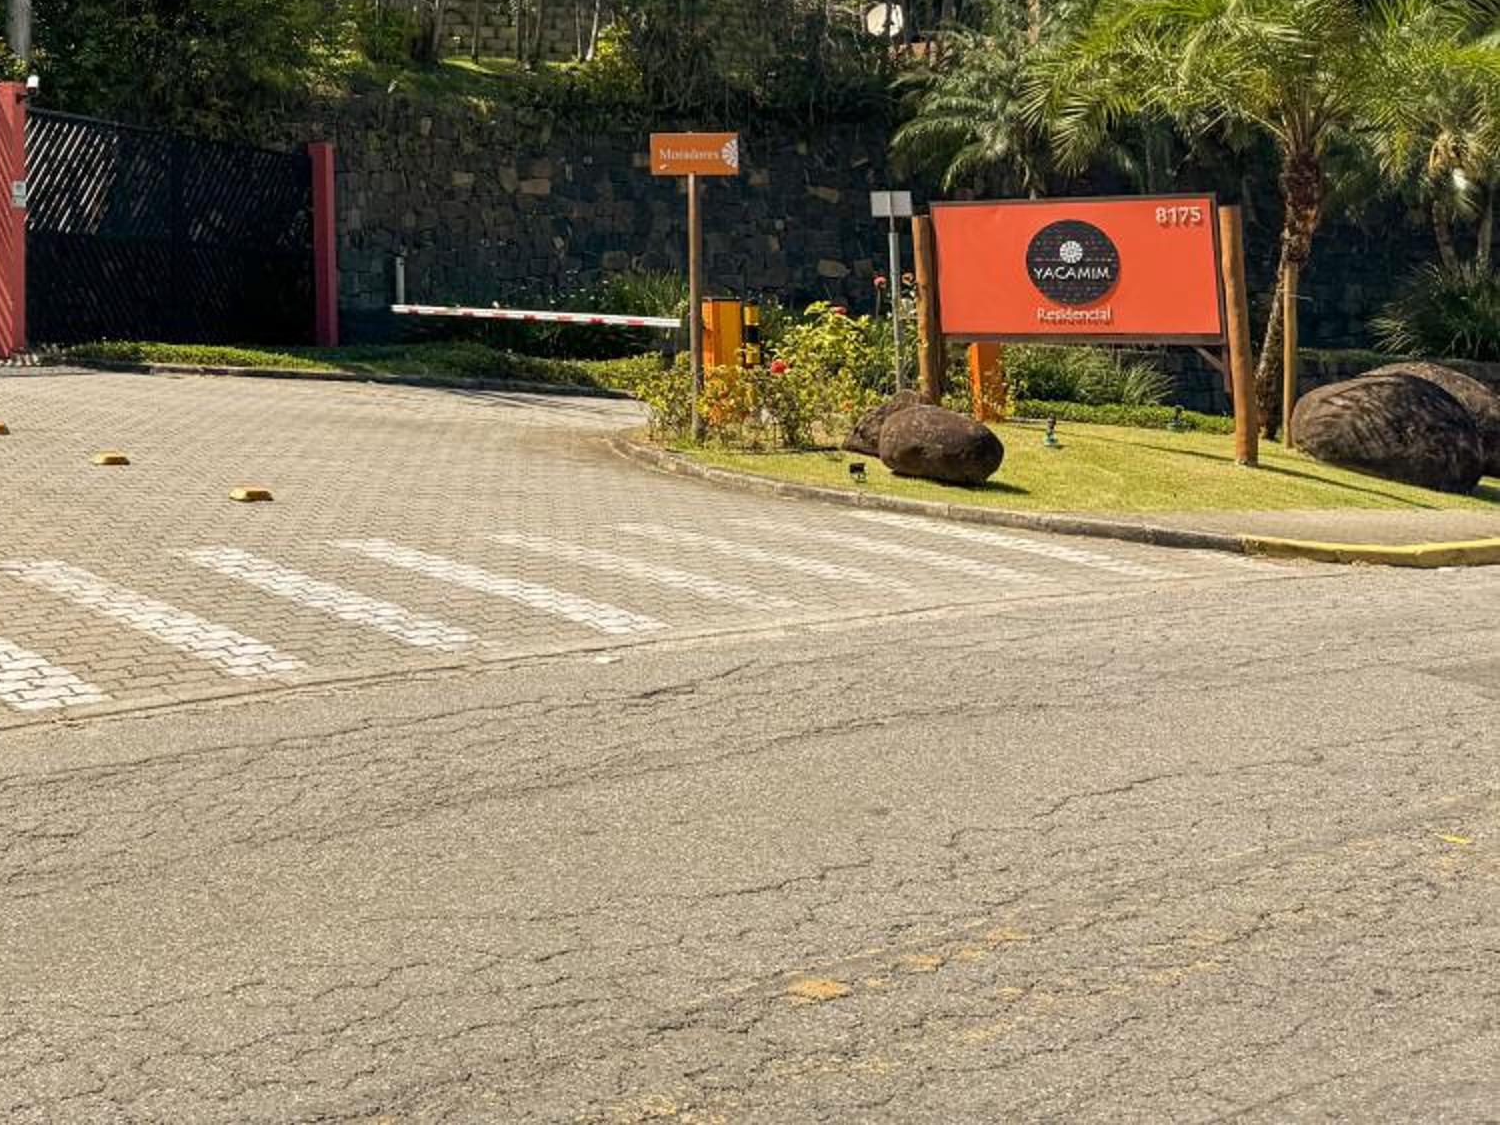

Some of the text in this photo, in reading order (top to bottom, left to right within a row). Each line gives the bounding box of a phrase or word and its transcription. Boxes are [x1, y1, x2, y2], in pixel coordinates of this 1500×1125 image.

[1155, 206, 1202, 224] 8175
[1033, 266, 1111, 281] YACAMIM
[1036, 307, 1111, 322] Residencial
